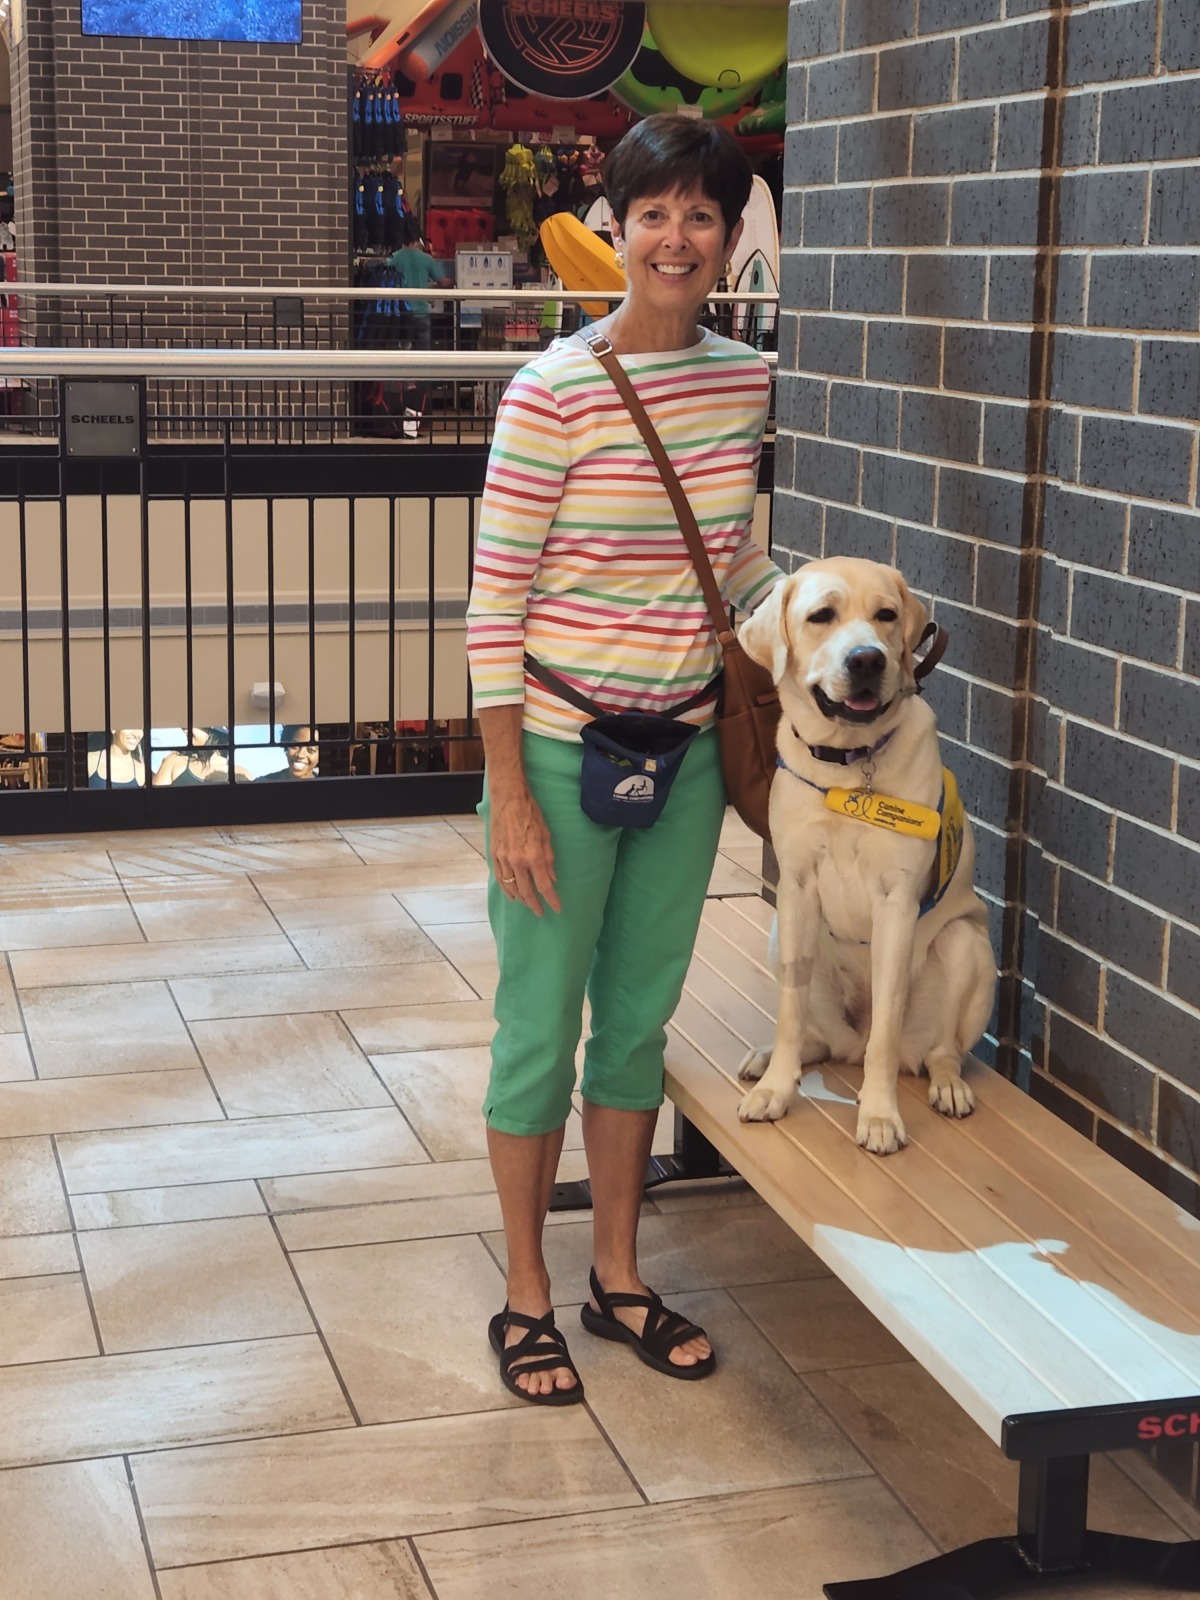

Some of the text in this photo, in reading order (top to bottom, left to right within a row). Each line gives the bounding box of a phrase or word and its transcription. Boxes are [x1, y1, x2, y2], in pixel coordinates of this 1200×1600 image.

[510, 0, 617, 20] SCHEELS
[403, 112, 479, 126] SPORTSSTUFF
[71, 414, 135, 425] SCHEELS
